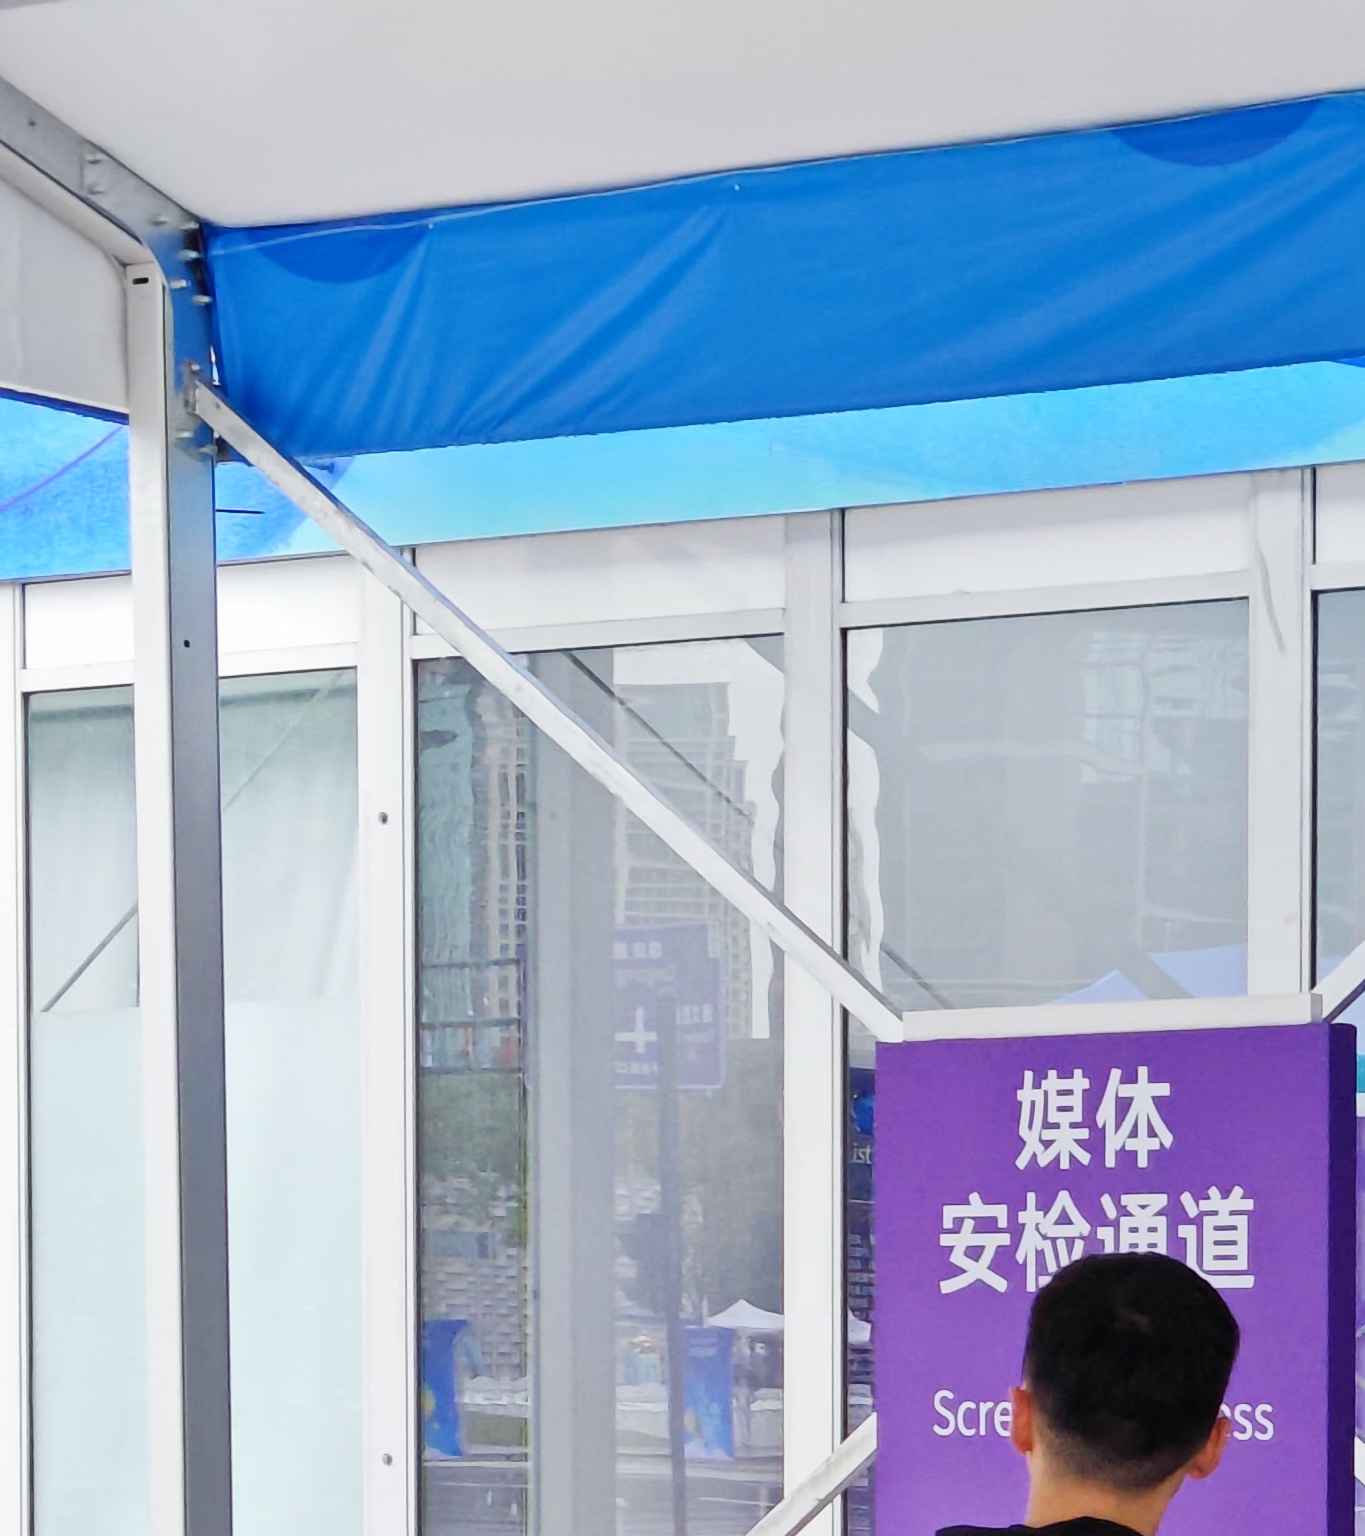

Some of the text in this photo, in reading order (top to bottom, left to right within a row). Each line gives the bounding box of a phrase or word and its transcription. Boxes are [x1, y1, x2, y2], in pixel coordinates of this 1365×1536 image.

[1015, 1065, 1174, 1170] 媒体
[938, 1185, 1256, 1296] 安检通道
